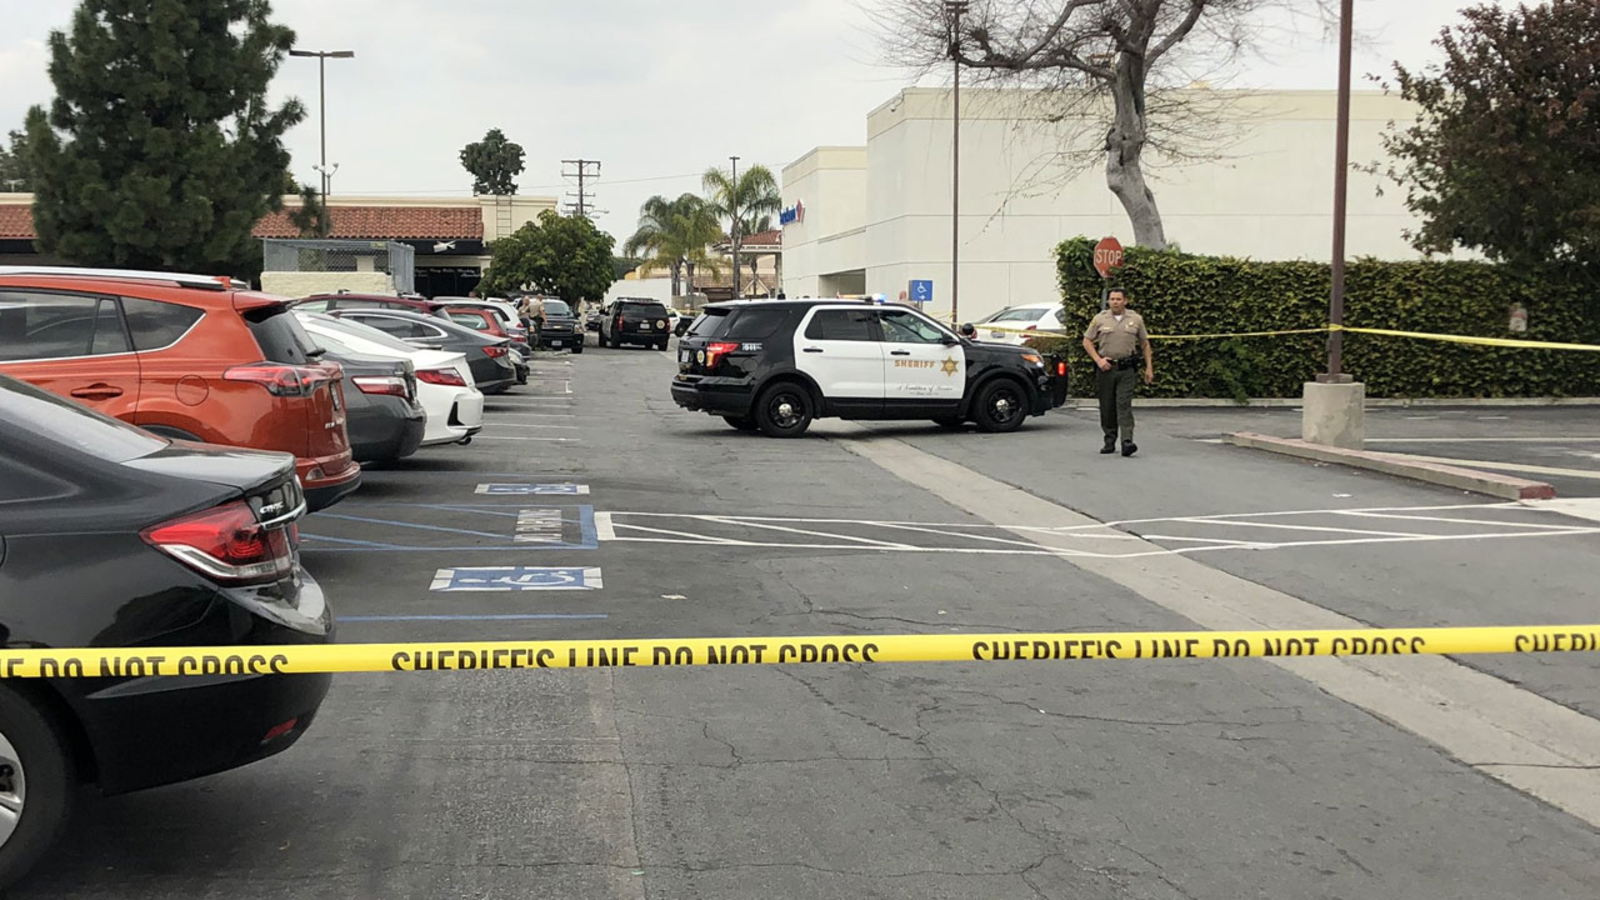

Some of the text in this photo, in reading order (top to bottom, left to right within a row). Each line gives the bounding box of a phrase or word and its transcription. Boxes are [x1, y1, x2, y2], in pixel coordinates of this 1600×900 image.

[1096, 249, 1122, 265] STOP
[894, 360, 936, 368] SHERIFF
[391, 643, 880, 670] SHERIFF'S LINE DO NOT CROSS
[973, 637, 1426, 660] SHERIFF'S LINE DO NOT CROSS
[39, 658, 84, 677] DO
[99, 656, 166, 677] NOT
